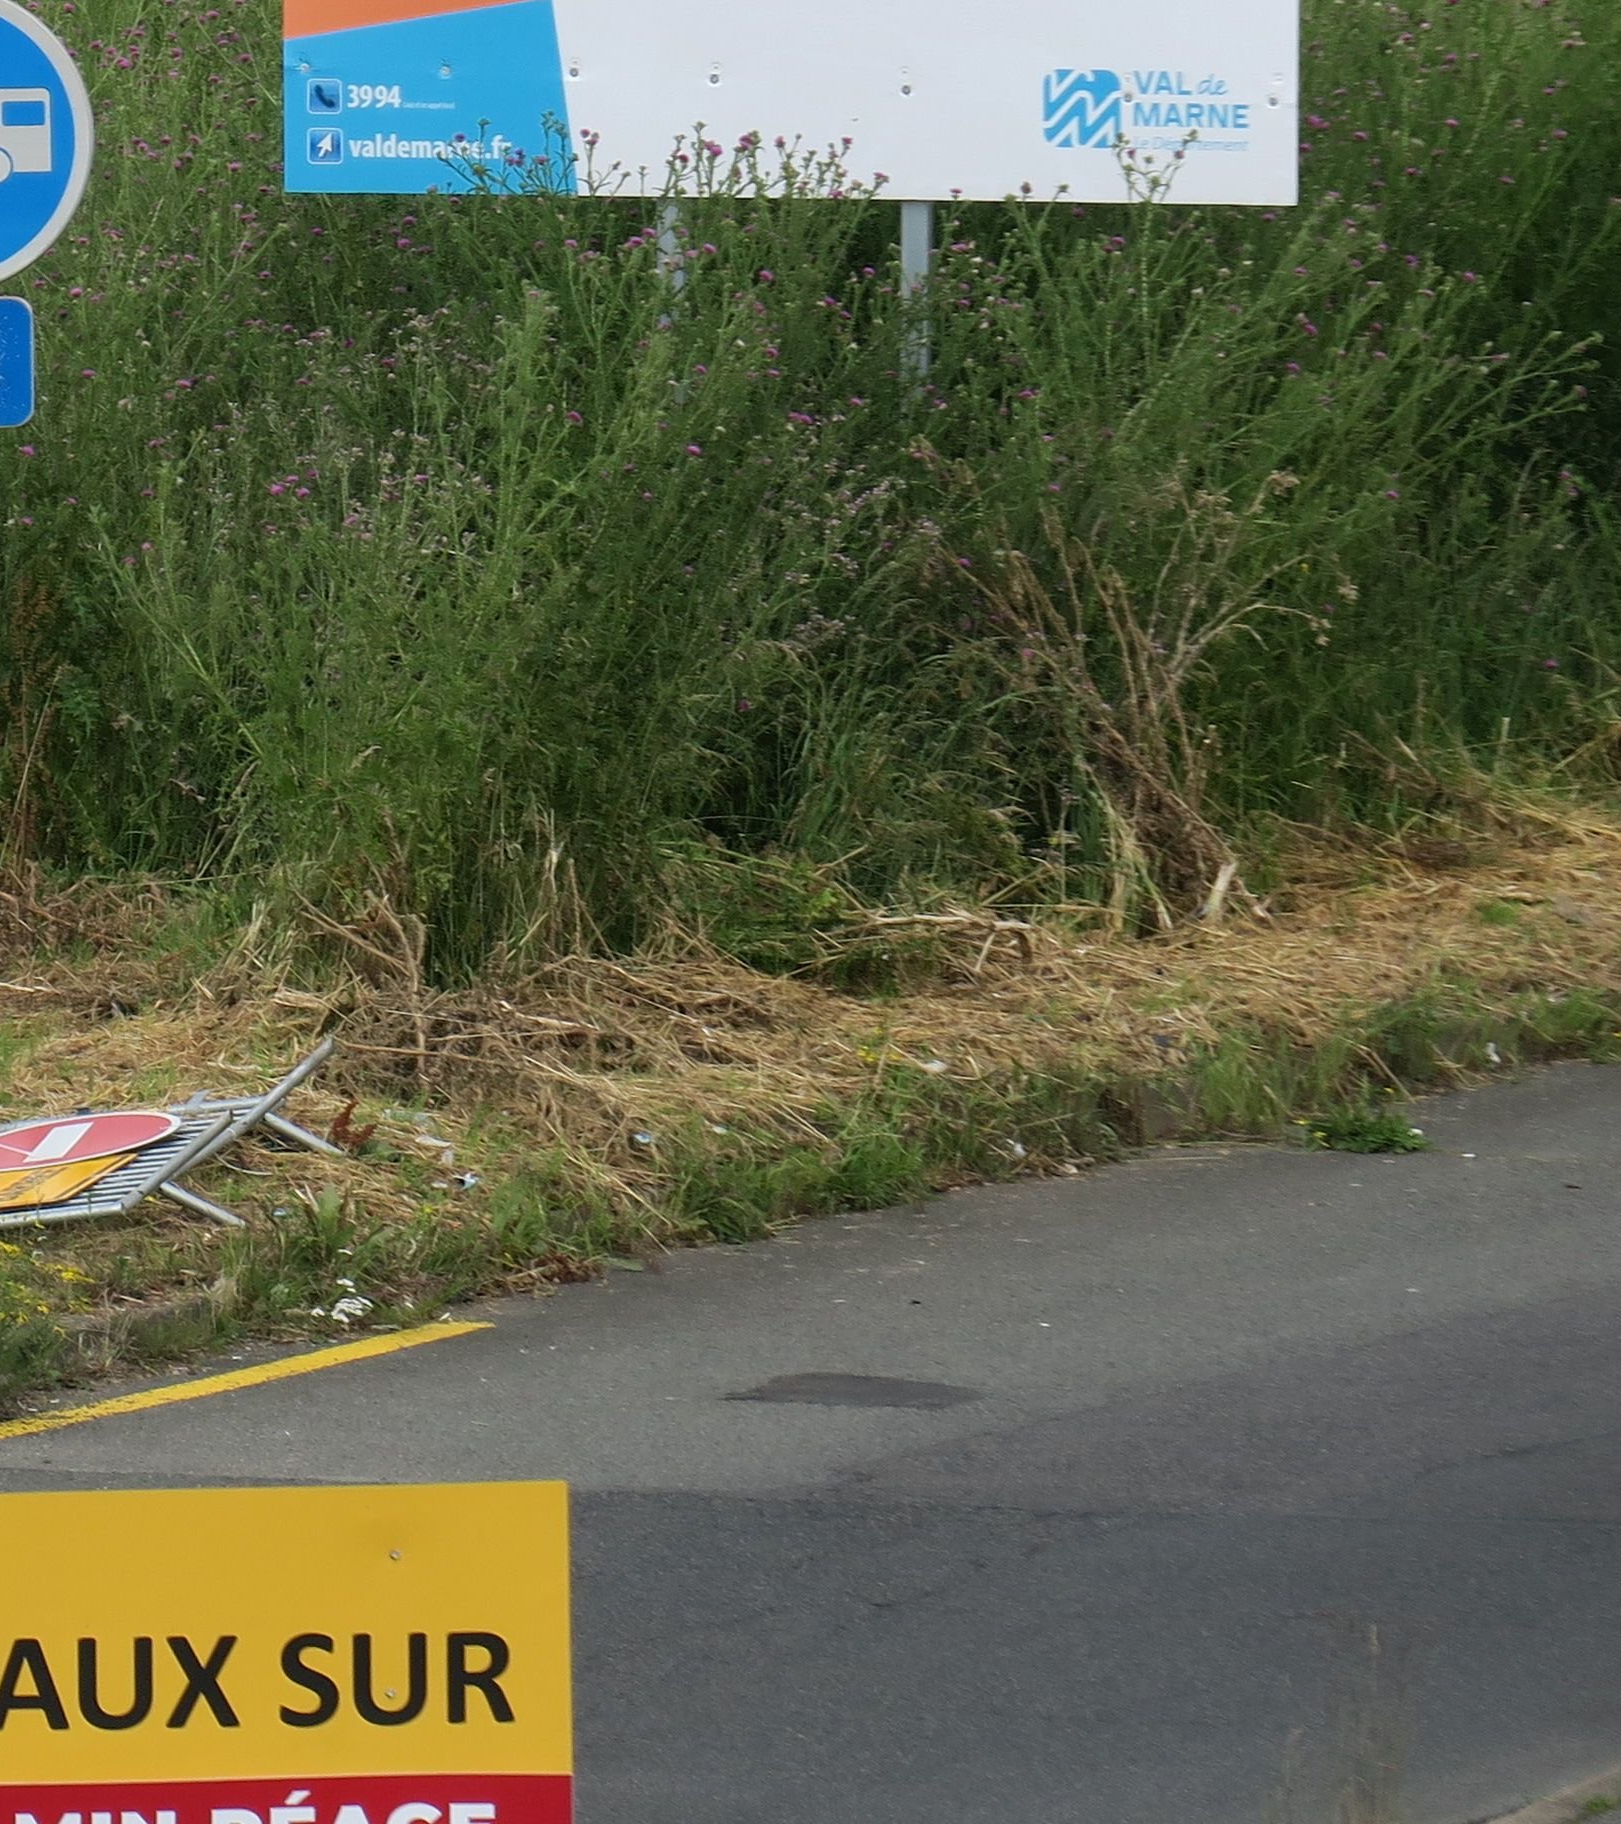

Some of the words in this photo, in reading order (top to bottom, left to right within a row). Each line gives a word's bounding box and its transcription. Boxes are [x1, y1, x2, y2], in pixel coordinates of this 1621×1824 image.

[347, 83, 402, 109] 3994
[1133, 70, 1192, 95] VAL
[1196, 74, 1229, 96] de
[1133, 103, 1250, 129] MARNE
[277, 1629, 515, 1729] SUR
